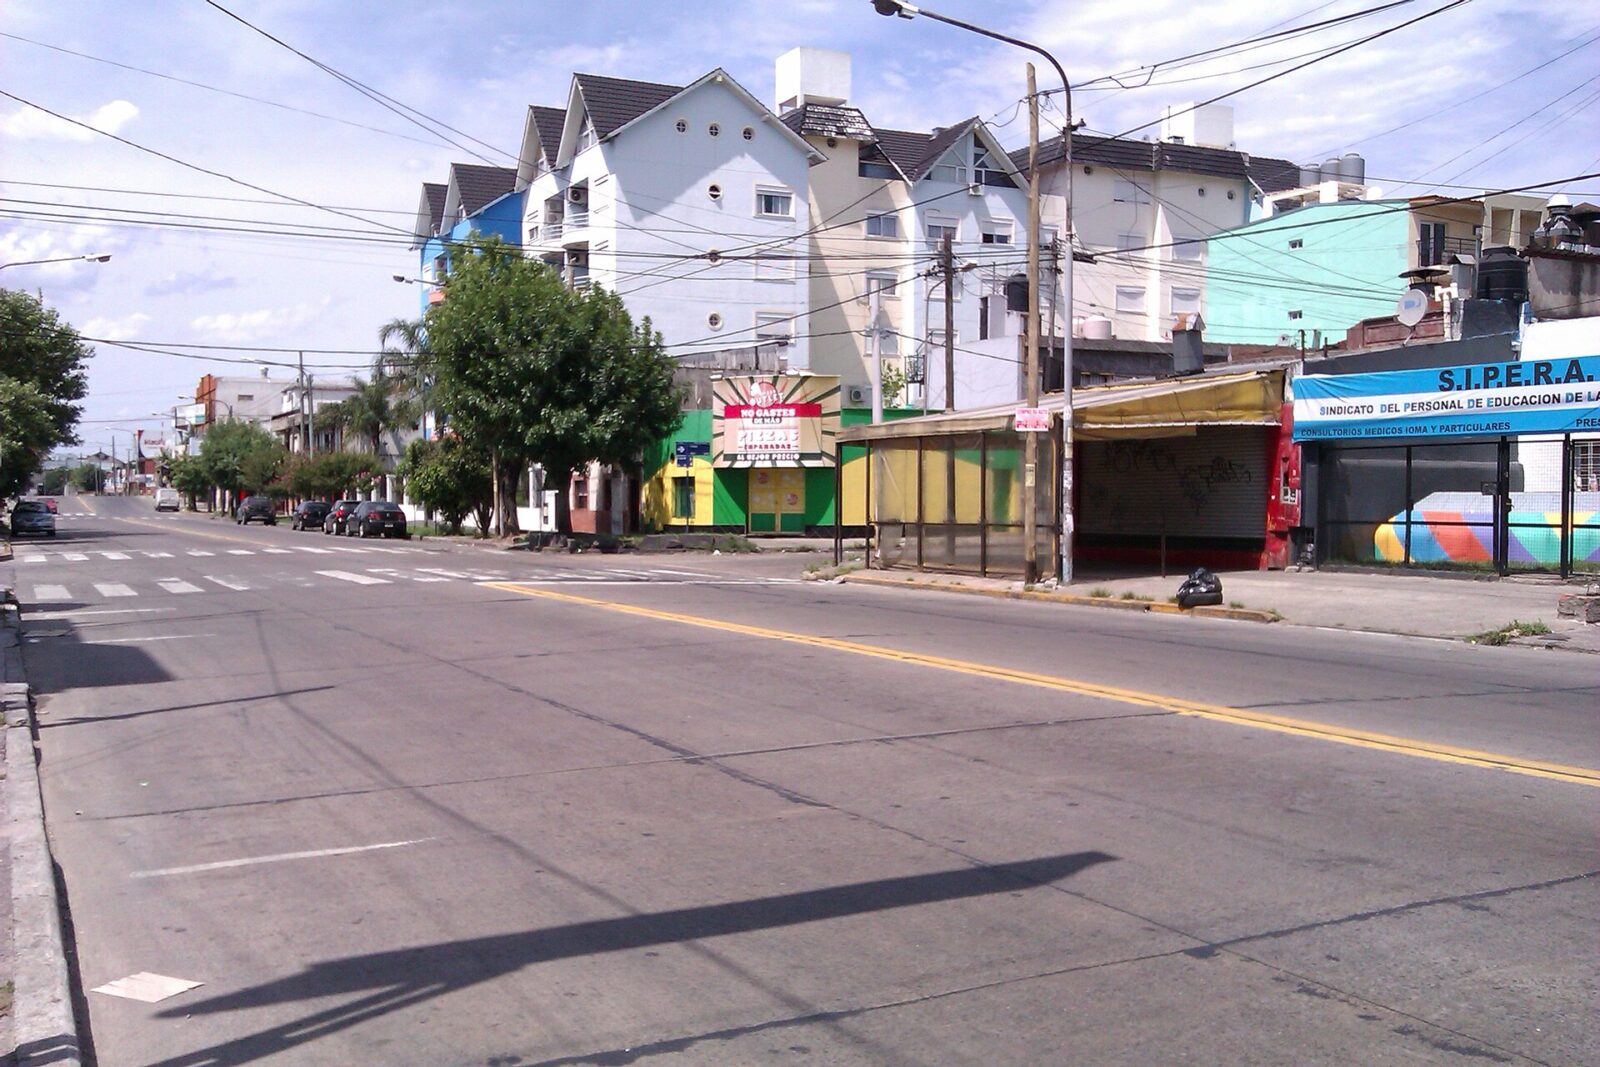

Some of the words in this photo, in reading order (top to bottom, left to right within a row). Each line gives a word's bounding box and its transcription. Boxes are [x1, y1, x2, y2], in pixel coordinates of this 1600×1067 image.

[1438, 359, 1594, 392] S.I.P.E.R.A.
[756, 408, 796, 417] GASTES
[1319, 404, 1374, 416] SINDICATO
[1380, 403, 1400, 413] DEL
[1404, 400, 1463, 412] PERSONAL
[1468, 398, 1482, 408] DE
[1486, 394, 1561, 408] EDUCACION
[1565, 392, 1582, 403] DE
[1301, 428, 1362, 436] CONSULTORIOS
[1364, 426, 1402, 436] MEDICOS
[1406, 425, 1428, 434] IOMA
[1440, 422, 1510, 432] PARTICULARES
